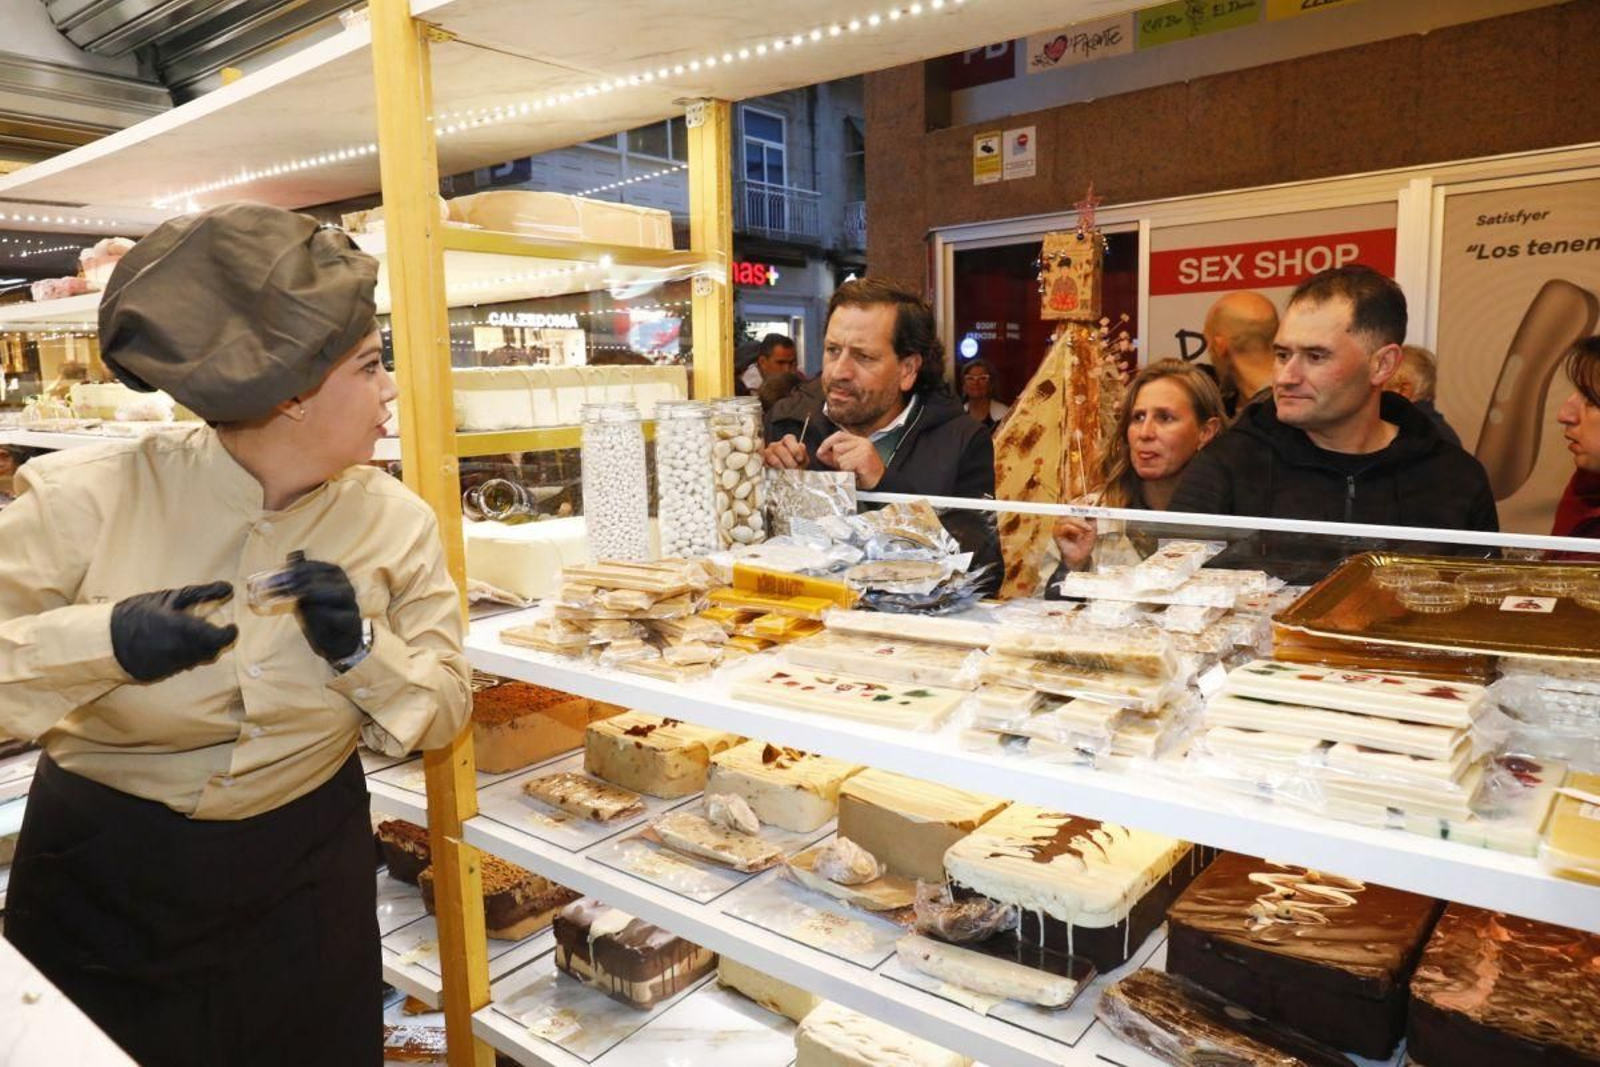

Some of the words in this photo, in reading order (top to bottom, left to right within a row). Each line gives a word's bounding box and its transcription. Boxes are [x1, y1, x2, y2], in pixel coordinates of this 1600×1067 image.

[1476, 209, 1550, 226] Satisfyer
[1178, 254, 1244, 285] SEX
[1254, 243, 1360, 280] SHOP
